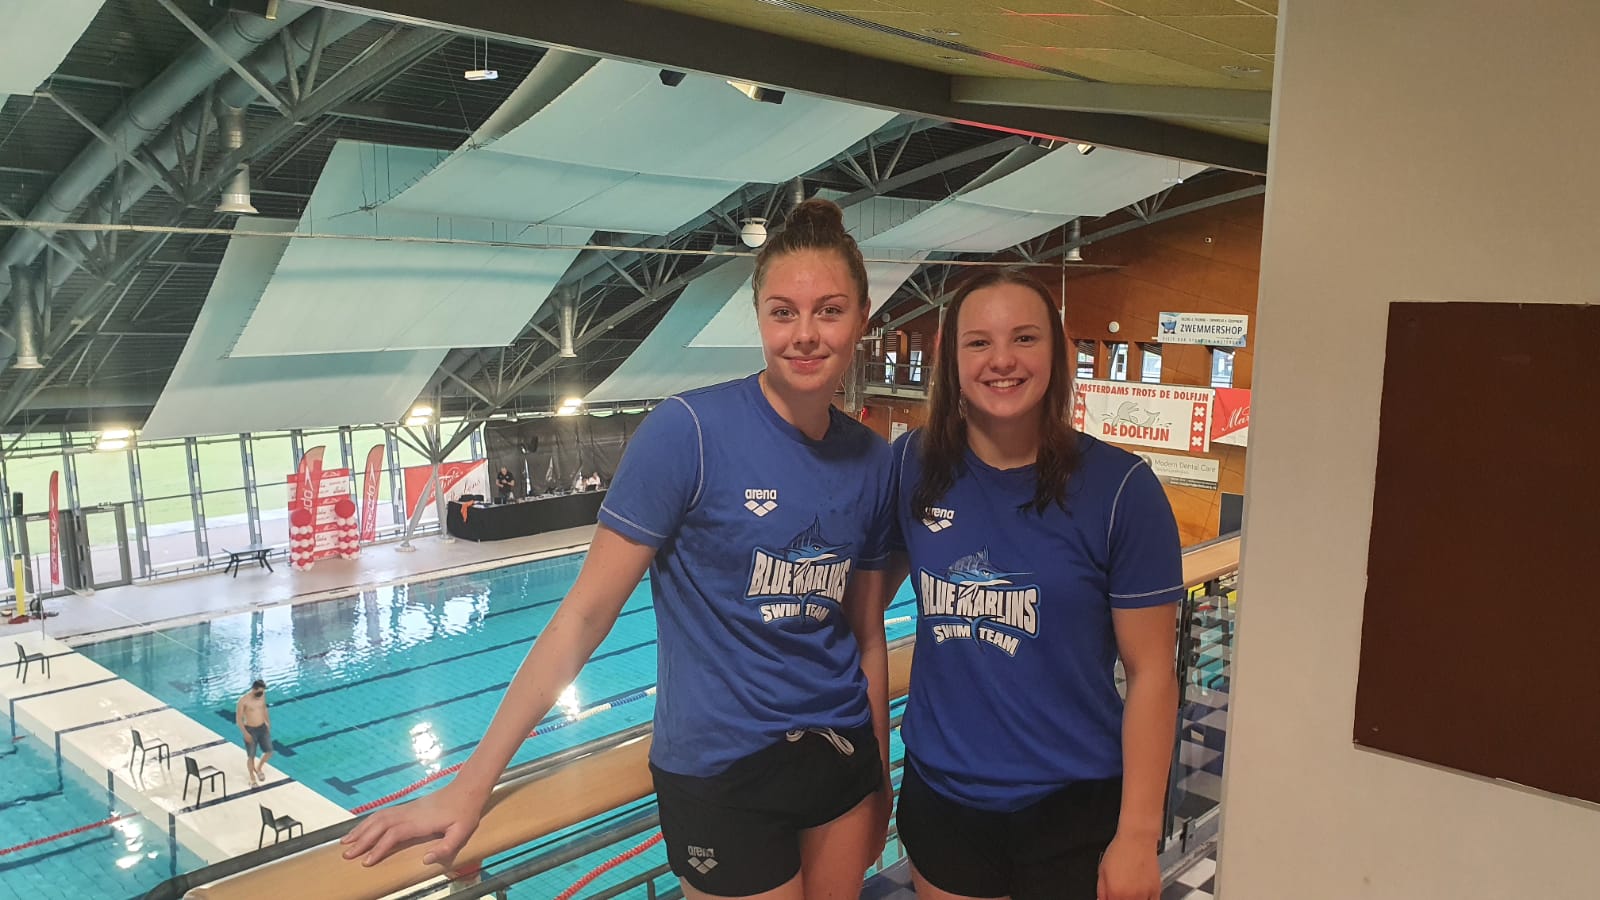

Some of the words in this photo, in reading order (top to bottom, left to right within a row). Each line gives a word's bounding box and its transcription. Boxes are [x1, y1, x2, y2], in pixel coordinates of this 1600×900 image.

[1180, 324, 1243, 335] ZWEMMERSHOP
[1132, 387, 1156, 399] TROTS
[1160, 390, 1171, 400] DE
[1173, 391, 1209, 402] DOLFIJN
[1102, 422, 1118, 437] DE
[1119, 425, 1170, 442] DOLFIJN
[1154, 459, 1178, 468] Modern
[1179, 461, 1200, 471] Dental
[1200, 464, 1216, 473] Care
[744, 488, 777, 500] arena
[747, 551, 793, 596] BLUE
[792, 558, 852, 603] MARLINS
[920, 570, 956, 616] BLUE
[956, 586, 1037, 635] MARLINS
[760, 603, 801, 623] SWIM
[805, 603, 830, 622] TEAM
[933, 624, 971, 643] SWIM
[978, 627, 1020, 656] TEAM
[687, 845, 715, 858] arena
